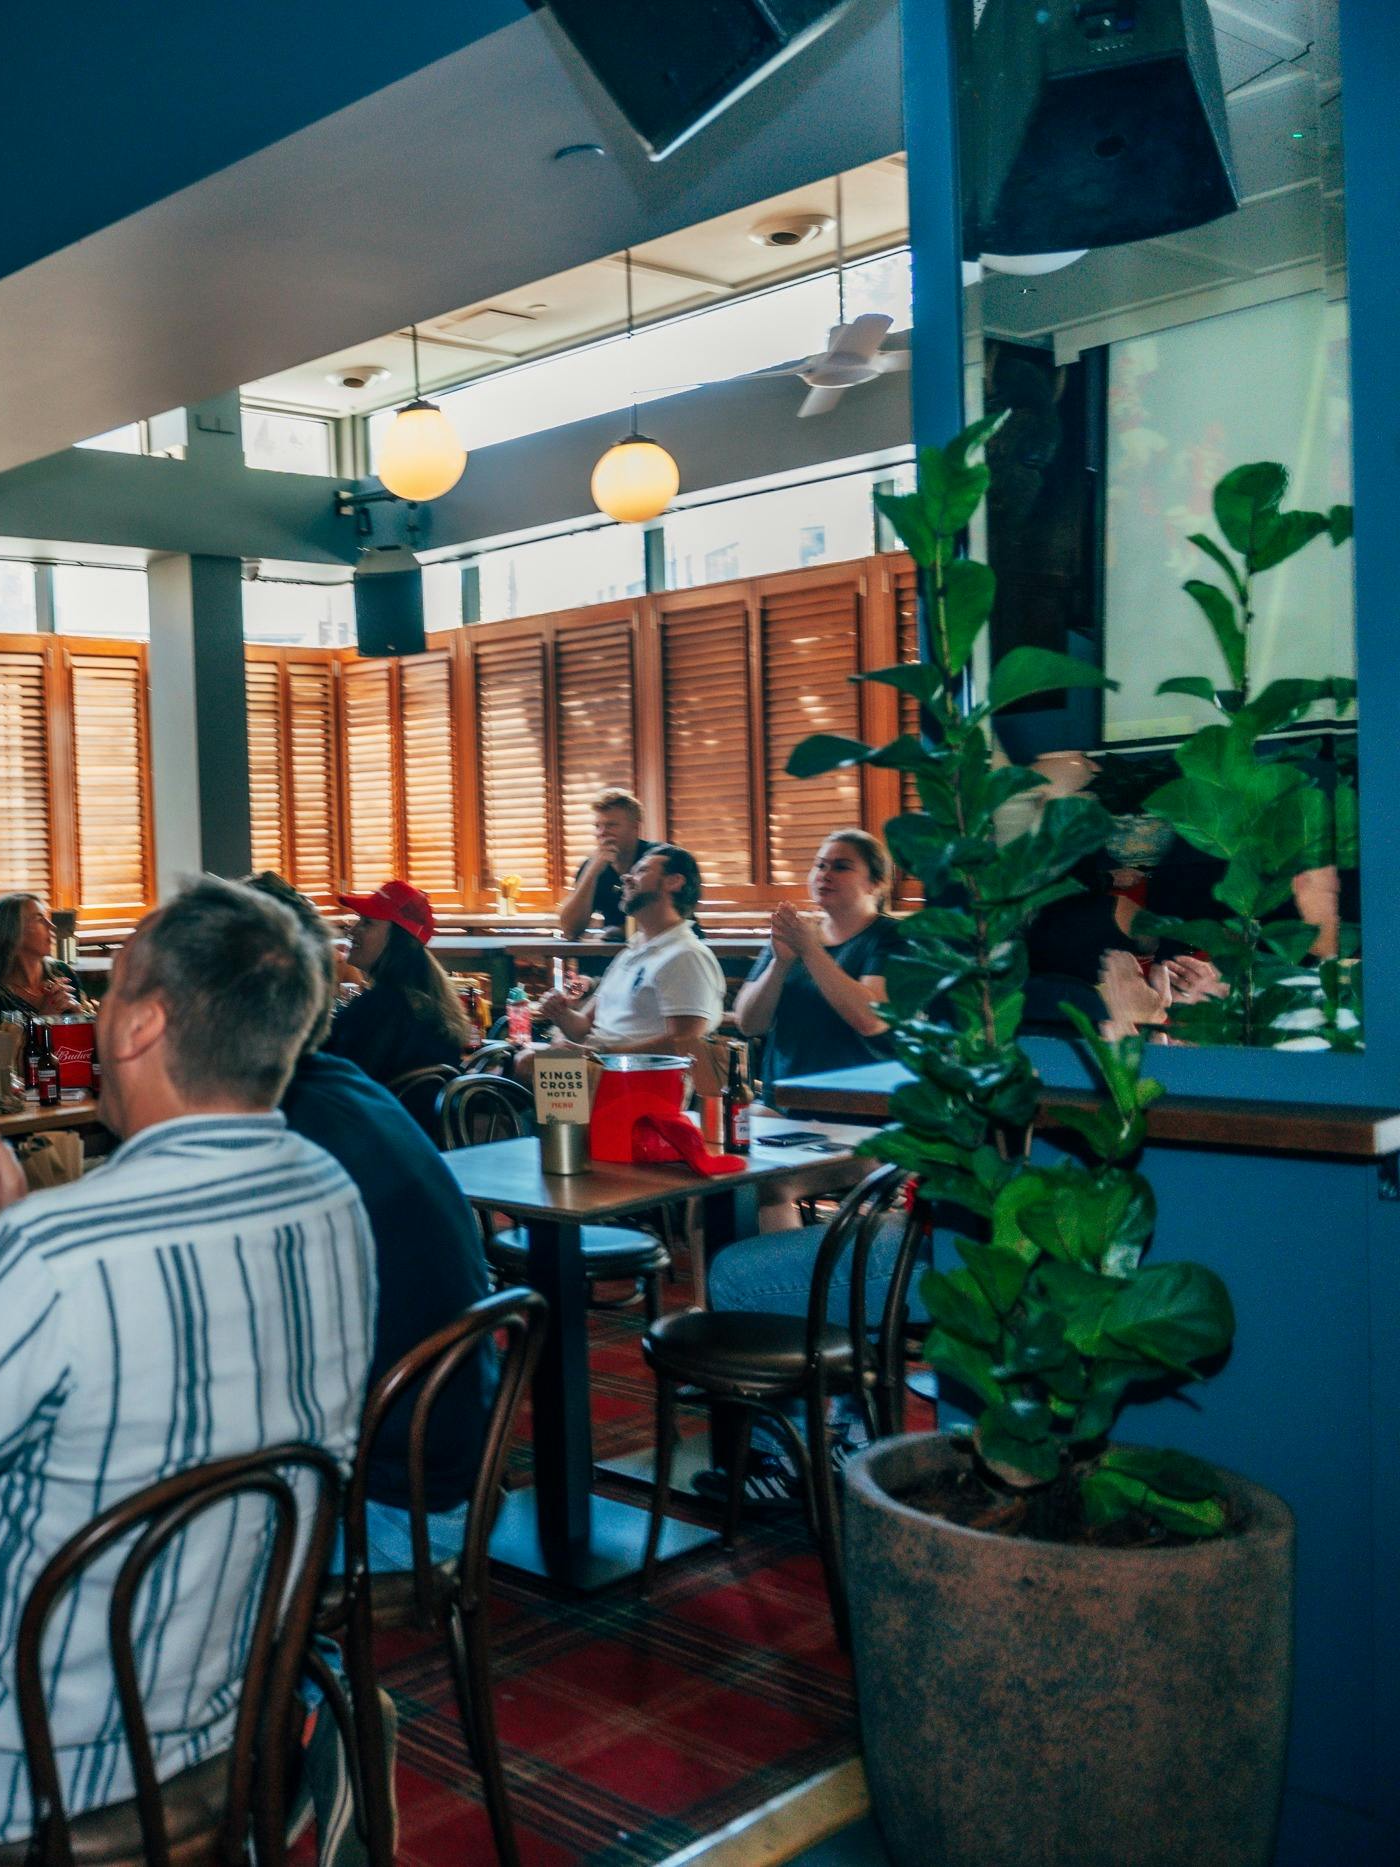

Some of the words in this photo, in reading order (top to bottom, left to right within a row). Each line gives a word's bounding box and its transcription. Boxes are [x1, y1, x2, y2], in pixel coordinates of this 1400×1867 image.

[58, 1050, 92, 1062] Budwe
[539, 1071, 582, 1080] KINGS
[540, 1081, 583, 1090] CROSS
